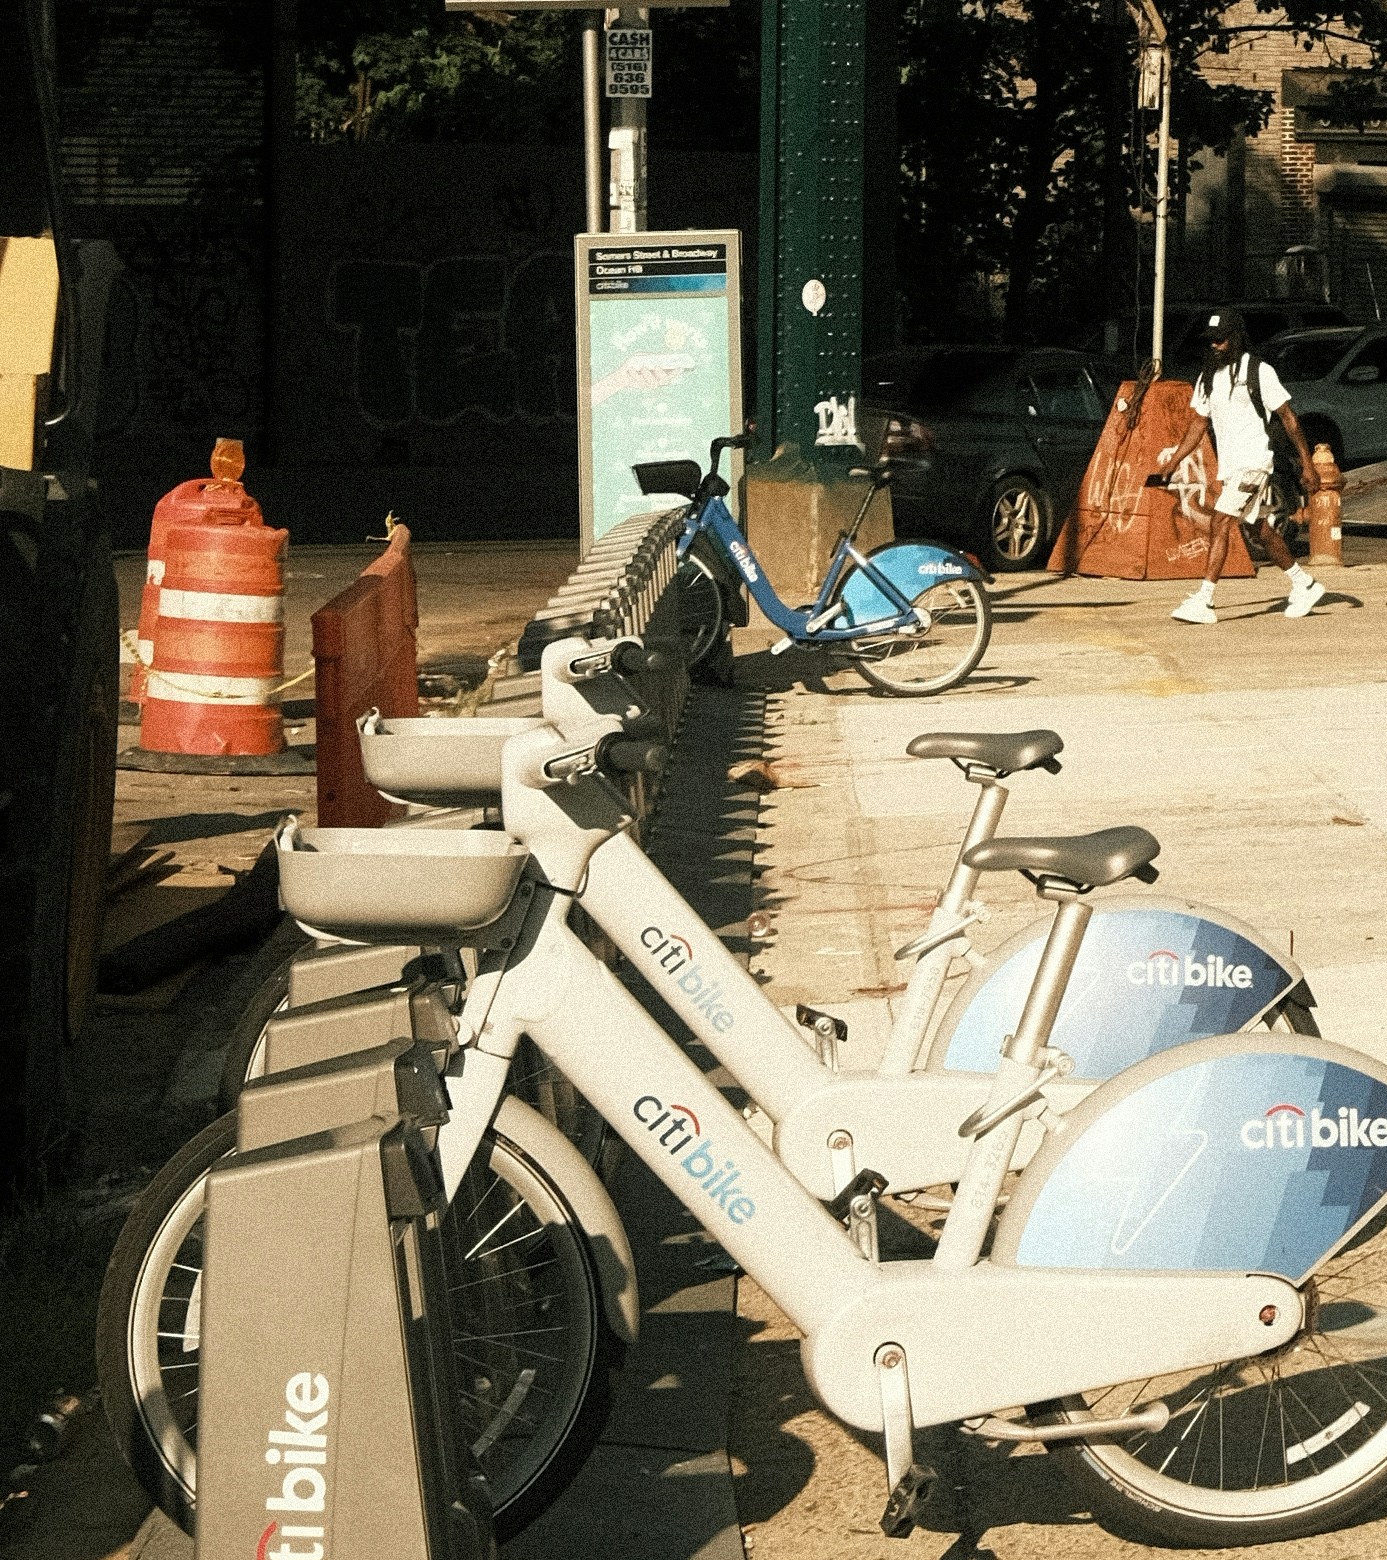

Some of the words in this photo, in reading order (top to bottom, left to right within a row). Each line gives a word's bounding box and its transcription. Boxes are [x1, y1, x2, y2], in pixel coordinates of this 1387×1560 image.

[608, 32, 650, 46] CASH
[640, 926, 692, 975] citi
[677, 964, 734, 1034] bike
[1126, 948, 1180, 986] citi
[1184, 954, 1253, 989] bike
[633, 1095, 701, 1155] citi
[681, 1139, 757, 1225] bike
[1240, 1103, 1306, 1149] citi
[265, 1372, 330, 1512] bike
